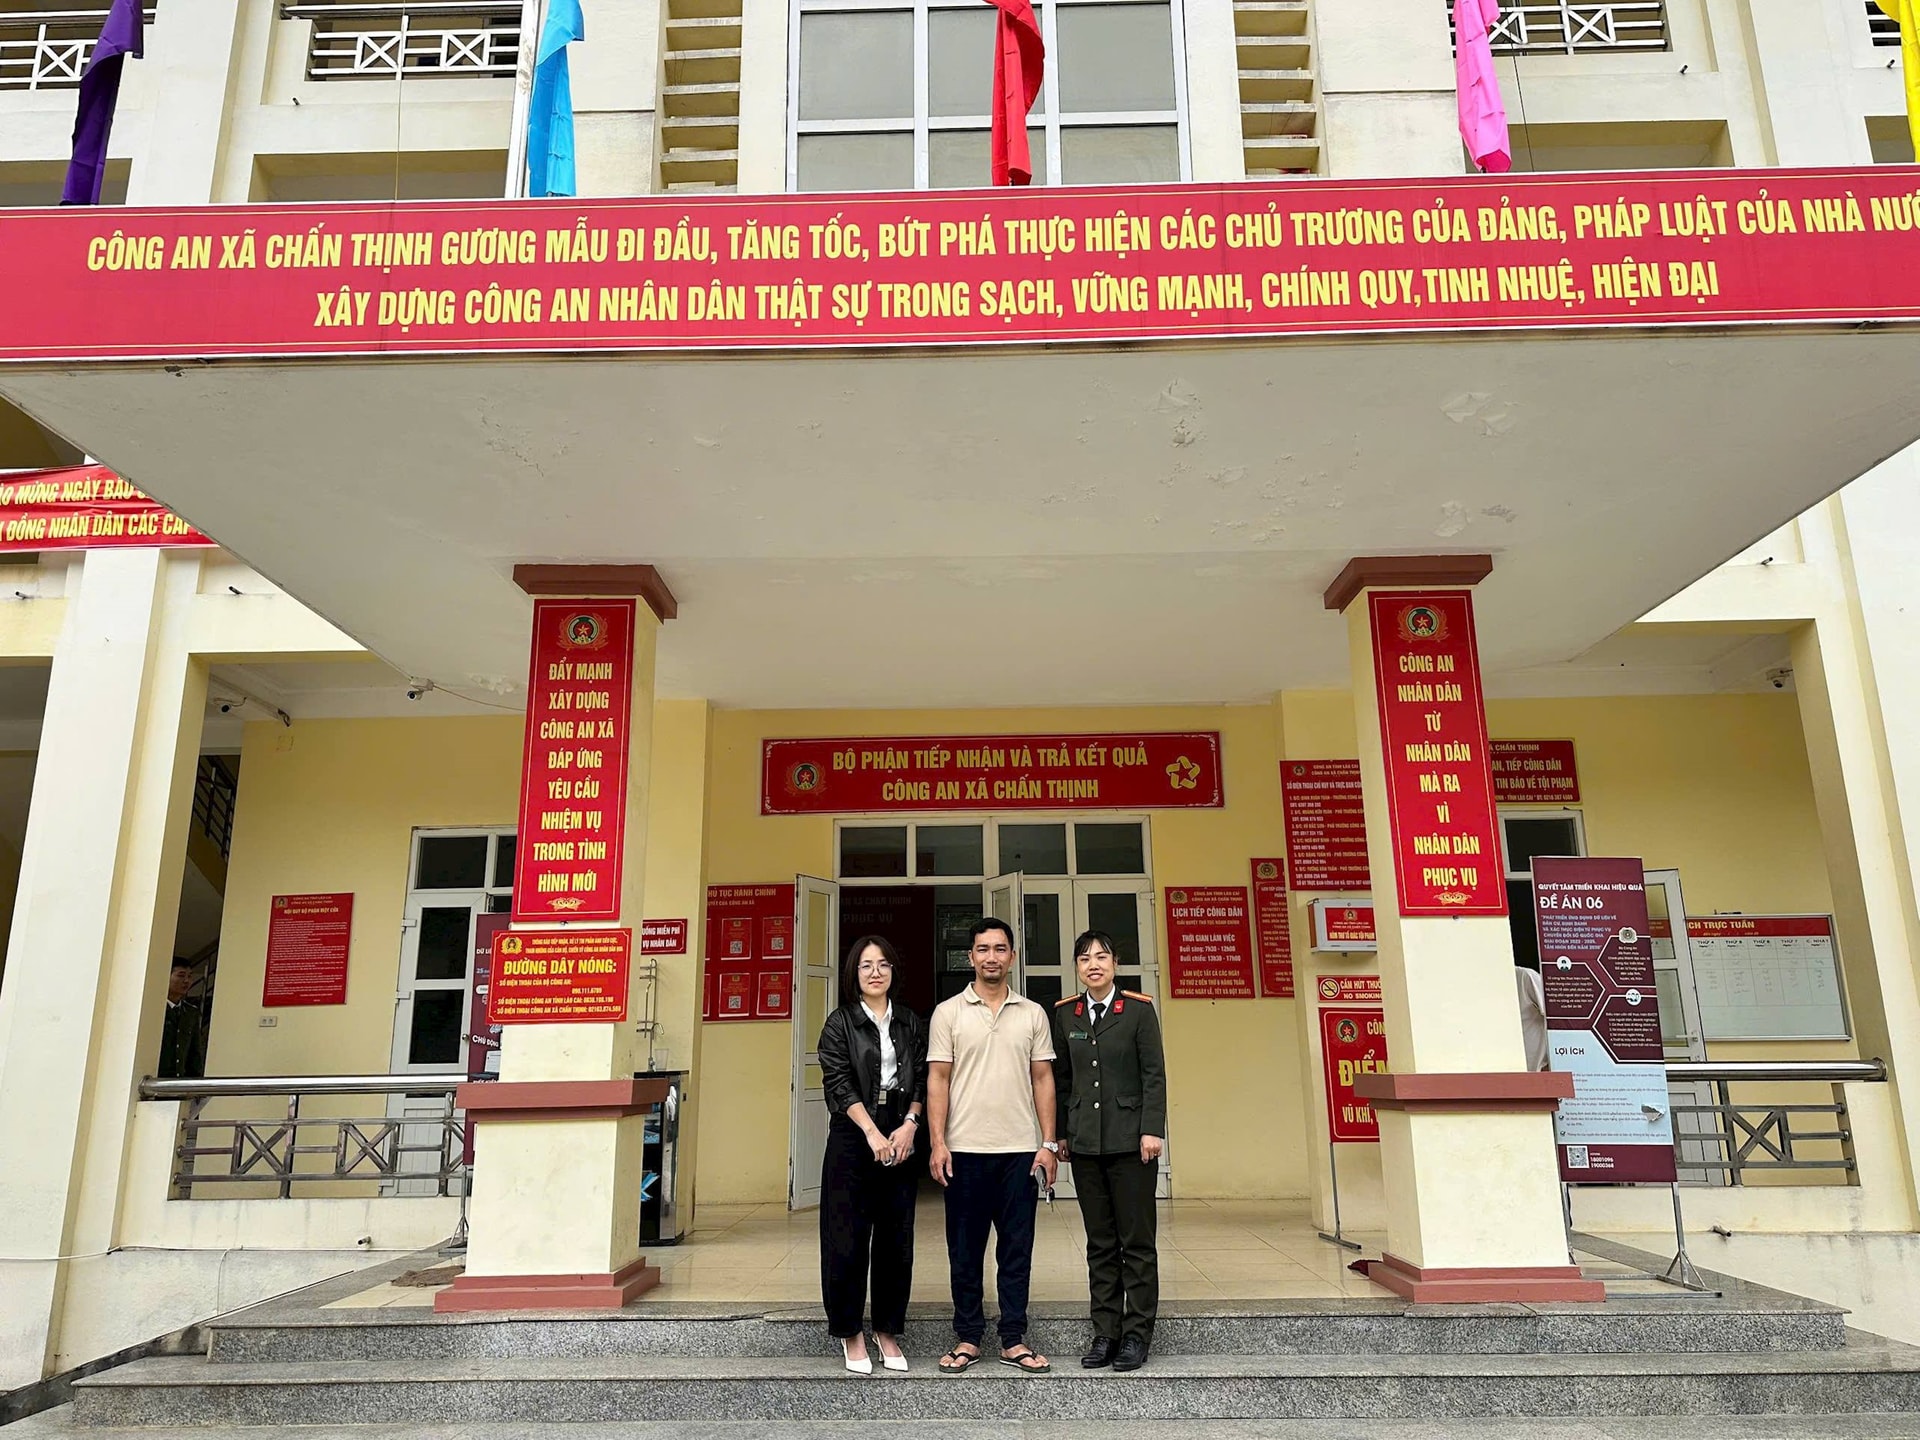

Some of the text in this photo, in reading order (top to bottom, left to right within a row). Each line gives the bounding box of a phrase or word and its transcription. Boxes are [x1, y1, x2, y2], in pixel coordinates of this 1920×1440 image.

[88, 230, 164, 270] CÔNG
[171, 236, 212, 269] AN
[219, 229, 255, 268] XÃ
[266, 223, 342, 268] CHẤN
[351, 233, 432, 273] THỊNH
[441, 228, 536, 265] GƯƠNG
[546, 217, 608, 262] MẪU
[617, 229, 644, 261] ĐI
[653, 216, 717, 264] ĐẦU,
[727, 220, 799, 259] TĂNG
[809, 213, 869, 262] TỐC,
[879, 216, 930, 257] BỨT
[940, 214, 996, 255] PHÁ
[1004, 216, 1075, 259] THỰC
[1085, 210, 1150, 258] HIỆN
[1160, 208, 1216, 250] CÁC
[1226, 202, 1282, 248] CHỦ
[1290, 208, 1404, 245] TRƯƠNG
[1413, 198, 1471, 243] CỦA
[1478, 196, 1566, 243] ĐẢNG,
[1574, 197, 1650, 238] PHÁP
[1659, 195, 1727, 242] LUẬT
[1737, 189, 1797, 234] CỦA
[1802, 191, 1865, 232] NHÀ
[314, 285, 371, 326] XÂY
[378, 288, 455, 332] DỰNG
[465, 283, 541, 324] CÔNG
[550, 288, 590, 322] AN
[599, 280, 678, 321] NHÂN
[688, 279, 745, 320] DÂN
[755, 278, 823, 326] THẬT
[832, 281, 872, 325] SỰ
[878, 282, 969, 317] TRONG
[980, 280, 1063, 322] SẠCH,
[1072, 271, 1148, 312] VỮNG
[1158, 274, 1252, 317] MẠNH,
[1262, 265, 1350, 307] CHÍNH
[1498, 258, 1584, 307] NHUỆ,
[1592, 257, 1661, 305] HIỆN
[1669, 262, 1719, 303] ĐẠI
[15, 476, 101, 504] MỪNG NGÀY
[48, 512, 88, 538] NHÂN
[92, 510, 124, 536] DÂN
[128, 509, 158, 536] CÁC
[549, 656, 613, 684] ĐẨY MẠNH
[1399, 652, 1454, 672] CÔNG AN
[548, 689, 609, 712] XÂY DỰNG
[1398, 681, 1462, 702] NHÂN DÂN
[540, 717, 614, 739] CÔNG AN XÃ
[1425, 712, 1441, 732] TỪ
[548, 747, 602, 768] ĐÁP ỨNG
[833, 741, 1148, 774] BỘ PHẬN TIẾP NHẬN VÀ TRẢ KẾT QUẢ
[1406, 741, 1471, 762] NHÂN DÂN
[1505, 757, 1522, 771] TIẾP
[1523, 758, 1544, 771] CÔNG
[1546, 758, 1562, 771] DÂN
[548, 775, 600, 799] YÊU CẦU
[883, 774, 1098, 803] CÔNG AN XÃ CHẤN THỊNH
[1420, 770, 1461, 792] MÀ RA
[1496, 777, 1509, 789] TIN
[1510, 776, 1525, 789] BÁO
[1537, 775, 1550, 791] TỘI
[1551, 777, 1574, 790] PHẠM
[541, 808, 602, 833] NHIỆM VỤ
[1437, 801, 1450, 823] VÌ
[533, 838, 606, 861] TRONG TÌNH
[1414, 833, 1480, 854] NHÂN DÂN
[538, 869, 597, 892] HÌNH MỚI
[1423, 867, 1478, 890] PHỤC VỤ
[1575, 882, 1592, 890] TRIỂN
[1612, 883, 1626, 891] HIỆU
[708, 888, 717, 897] HỦ
[1540, 893, 1603, 909] ĐỀ ÁN 06
[1172, 905, 1243, 919] LỊCH TIẾP CÔNG DÂN
[1704, 921, 1728, 930] TRỰC
[1730, 920, 1755, 929] TUẦN
[1182, 934, 1194, 942] THỜI
[1210, 934, 1222, 942] LÀM
[1223, 933, 1235, 942] VIỆC
[503, 957, 547, 975] ĐƯỜNG
[550, 957, 575, 975] DÂY
[577, 956, 617, 974] NÓNG:
[1340, 977, 1353, 989] CẤM
[1353, 979, 1365, 989] HÚT
[1367, 1019, 1386, 1035] CÔN
[1554, 1046, 1584, 1056] LỢI ÍCH
[1342, 1103, 1374, 1125] VŨ KHÍ,
